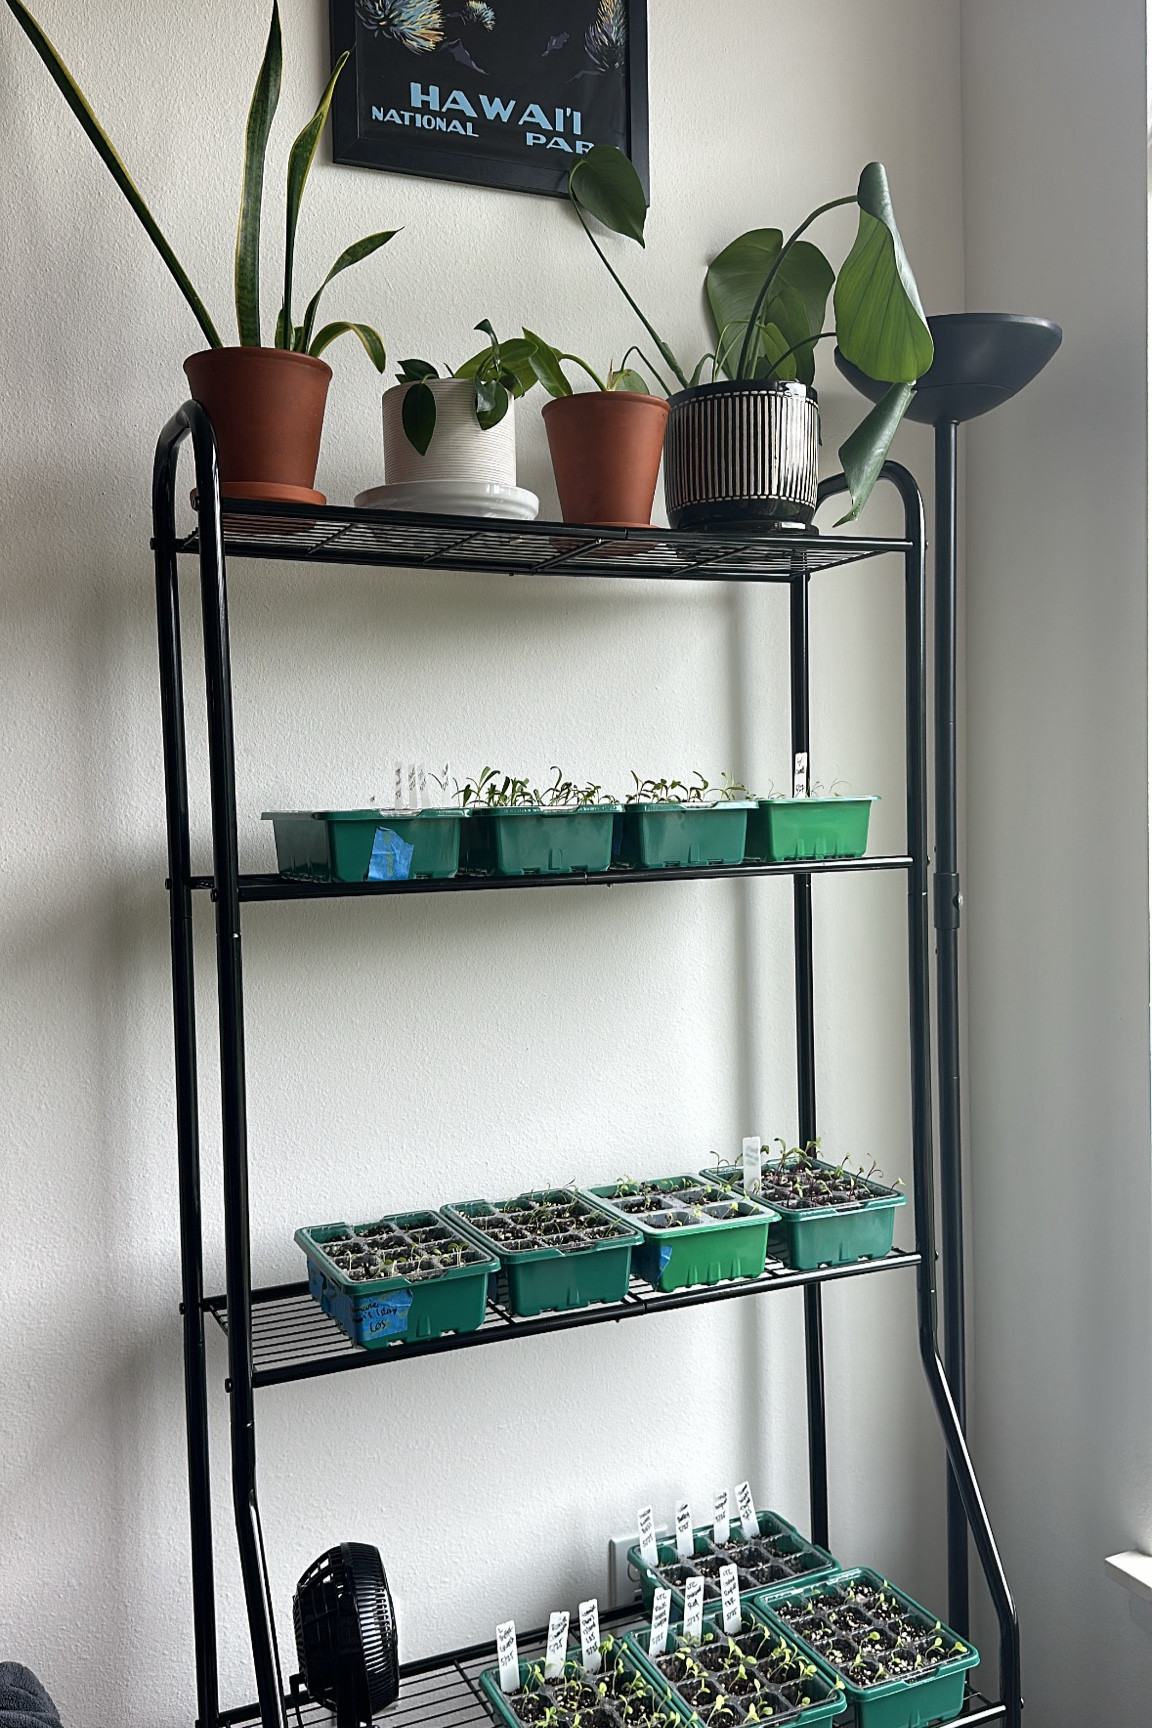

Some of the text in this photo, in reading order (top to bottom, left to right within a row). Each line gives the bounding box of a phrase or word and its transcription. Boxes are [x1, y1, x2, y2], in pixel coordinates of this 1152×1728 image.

[371, 105, 595, 155] NATIONAL PAR
[410, 81, 582, 135] HAWAI'I
